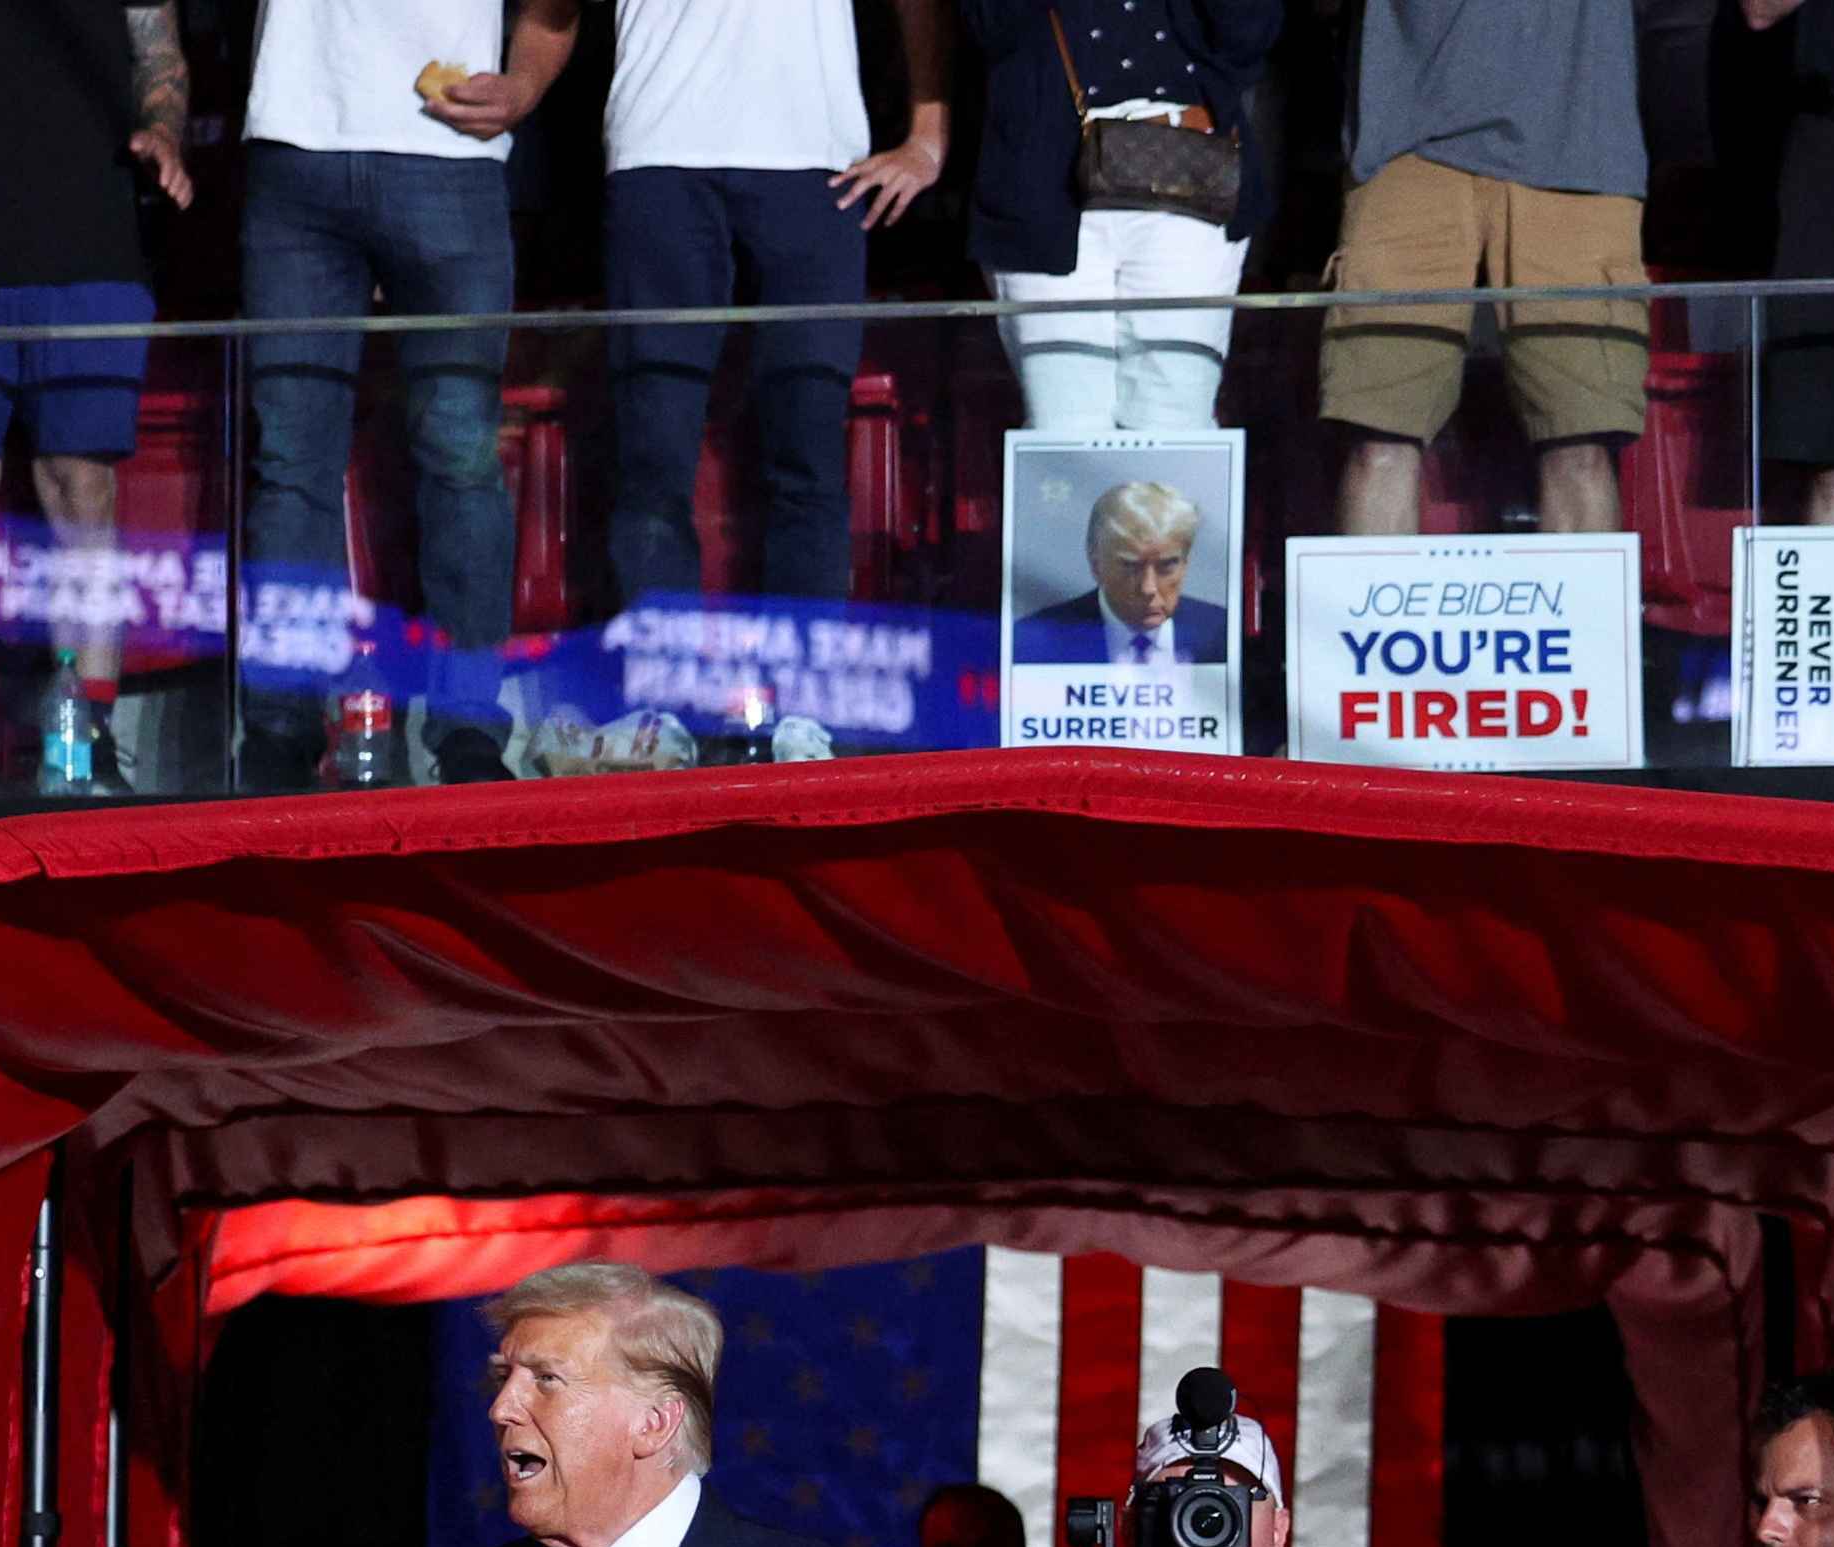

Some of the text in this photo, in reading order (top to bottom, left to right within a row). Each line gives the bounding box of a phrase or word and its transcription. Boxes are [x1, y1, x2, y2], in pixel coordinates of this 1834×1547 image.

[1348, 582, 1564, 618] JOE BIDEN,
[1339, 628, 1573, 677] YOU'RE
[1775, 549, 1799, 750] SURRENDER
[1808, 595, 1832, 706] NEVER
[1065, 685, 1175, 707] NEVER
[1339, 688, 1590, 741] FIRED!
[1021, 716, 1221, 741] SURRENDER
